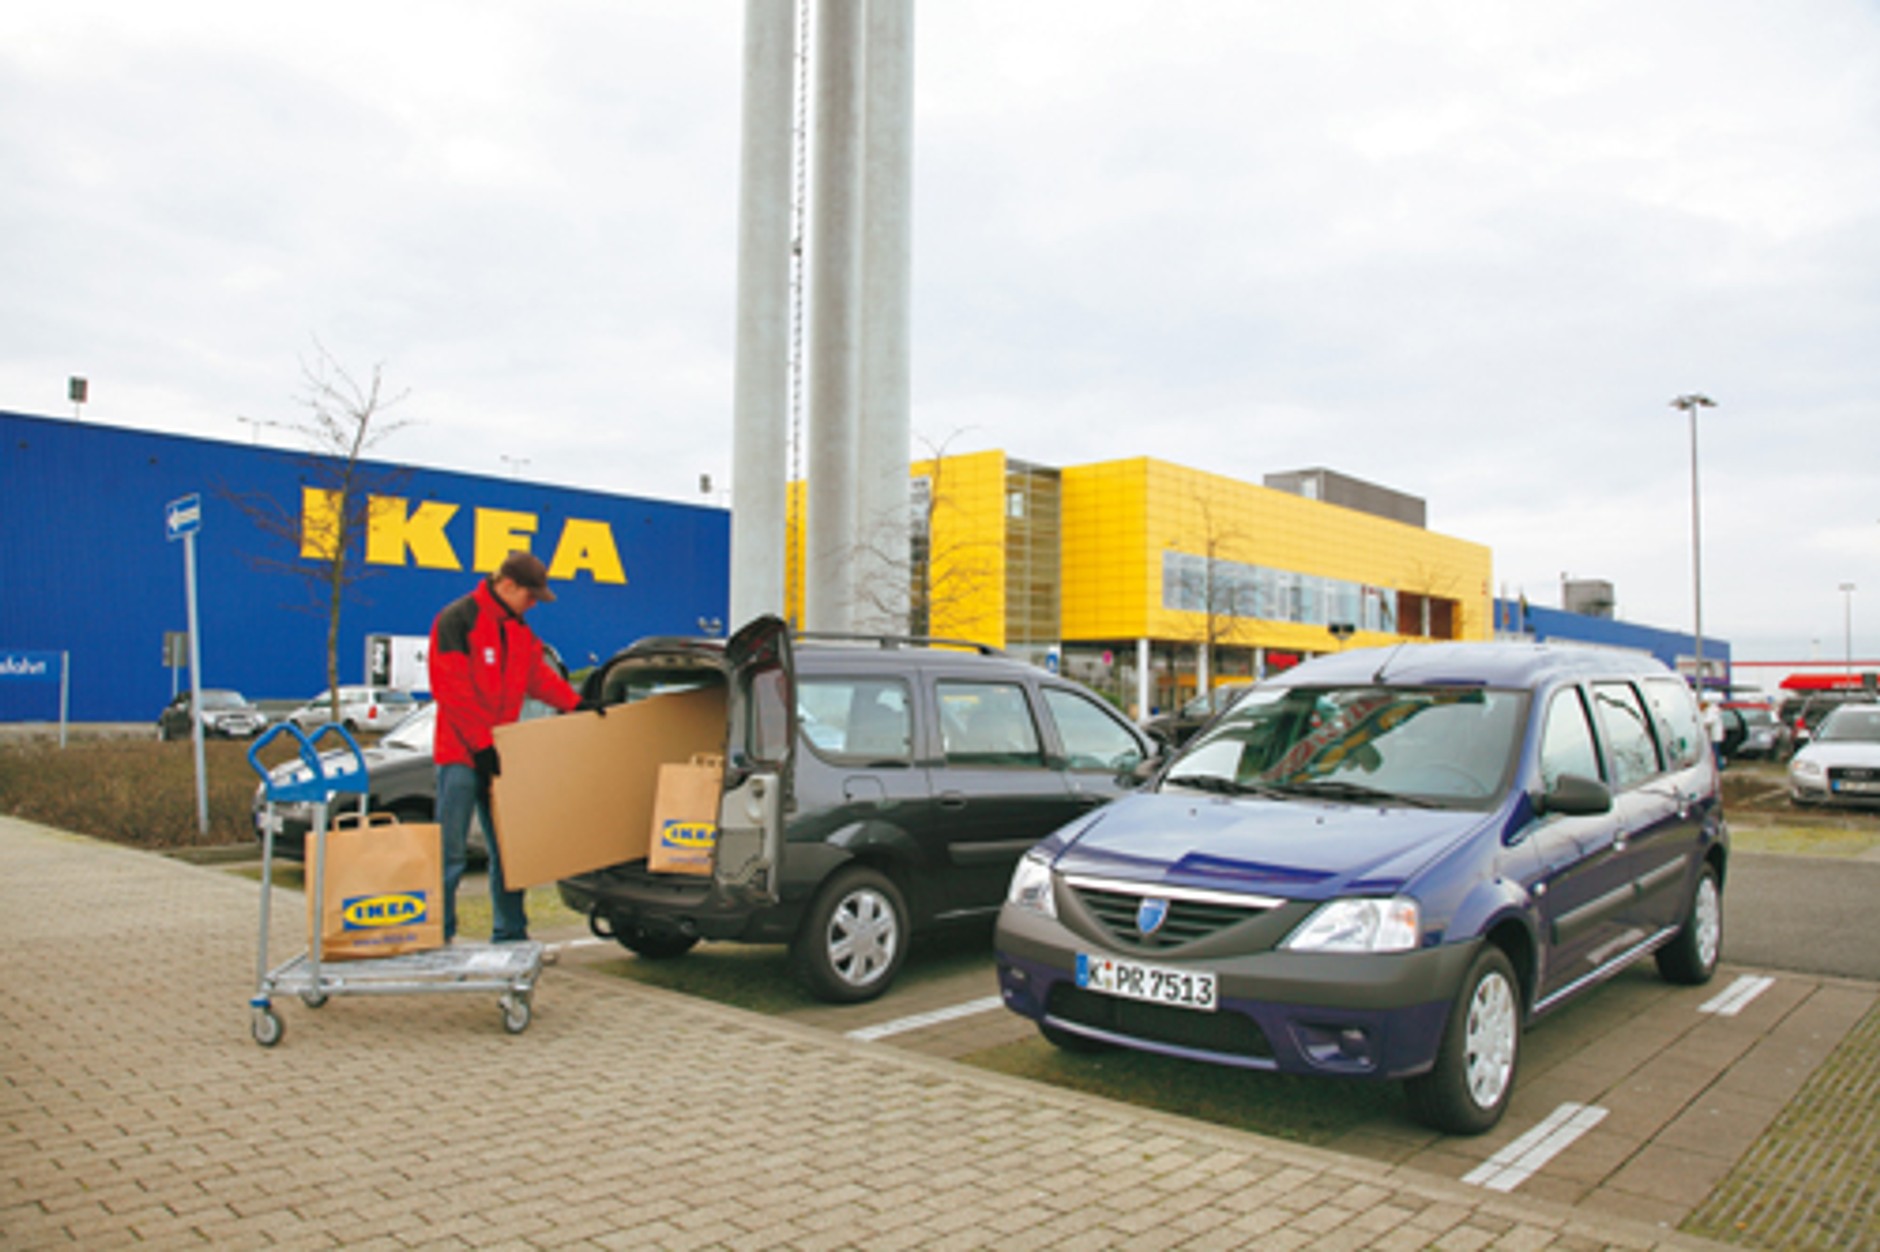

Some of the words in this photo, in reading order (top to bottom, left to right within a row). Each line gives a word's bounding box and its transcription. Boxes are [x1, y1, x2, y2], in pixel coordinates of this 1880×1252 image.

[300, 487, 627, 585] IKEA
[355, 902, 415, 919] IKEA
[1150, 969, 1212, 1005] 7513
